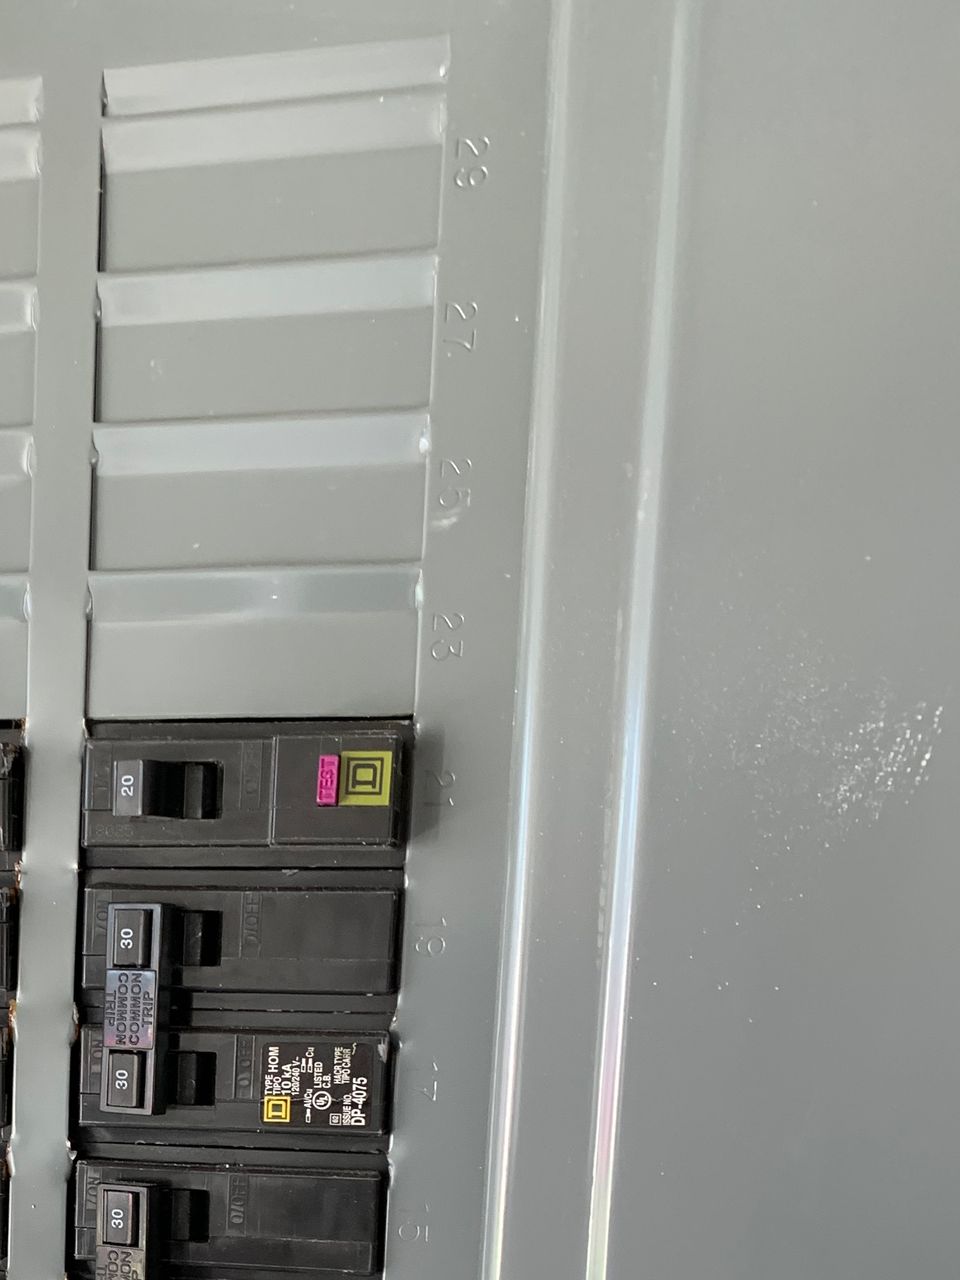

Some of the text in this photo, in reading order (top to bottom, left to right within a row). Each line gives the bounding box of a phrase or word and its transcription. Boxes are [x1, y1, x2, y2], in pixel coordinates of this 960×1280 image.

[430, 611, 465, 662] 23
[122, 775, 134, 797] 20
[318, 759, 335, 800] TEST
[121, 928, 133, 949] 30
[129, 973, 142, 1045] COMMON
[142, 991, 153, 1027] TRIP
[268, 1047, 279, 1072] HOM
[116, 1069, 128, 1090] 30
[352, 1077, 367, 1126] DP-4075
[111, 1209, 124, 1229] 30
